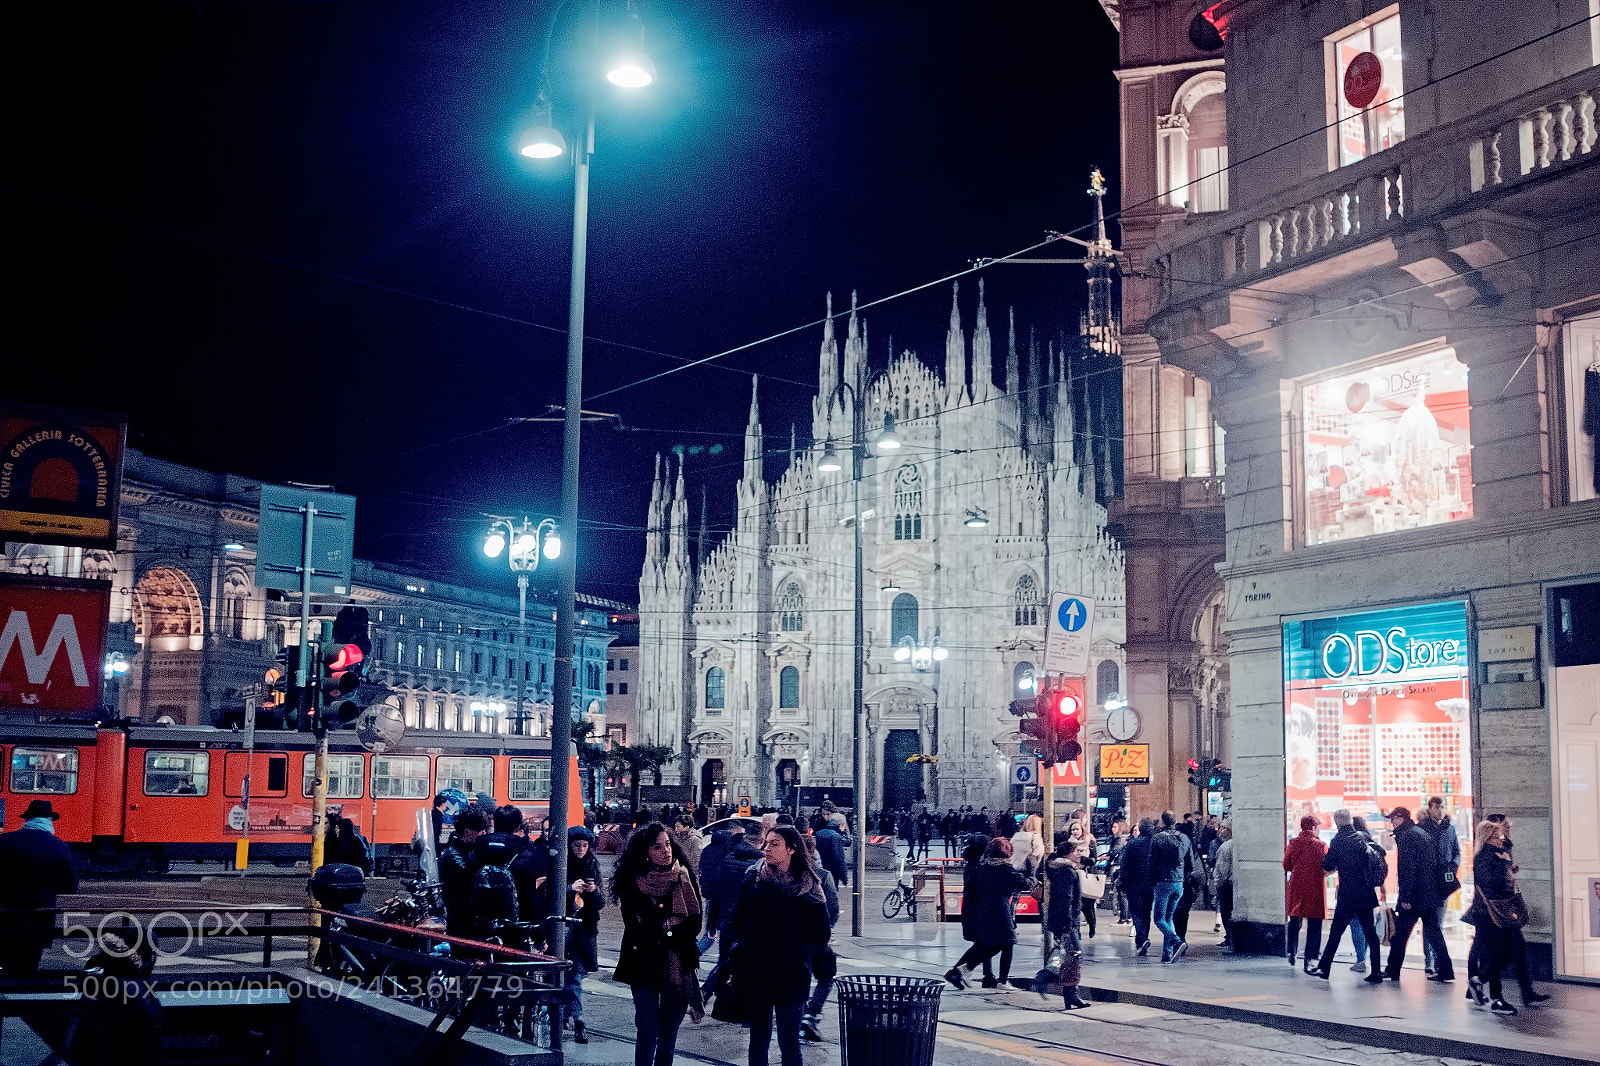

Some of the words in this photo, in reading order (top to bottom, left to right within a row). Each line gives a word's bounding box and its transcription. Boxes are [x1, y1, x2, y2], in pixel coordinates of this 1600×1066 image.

[10, 430, 62, 458] GALLERIA
[1244, 592, 1272, 602] TORINO
[0, 610, 90, 687] M
[1322, 626, 1461, 681] ODStore
